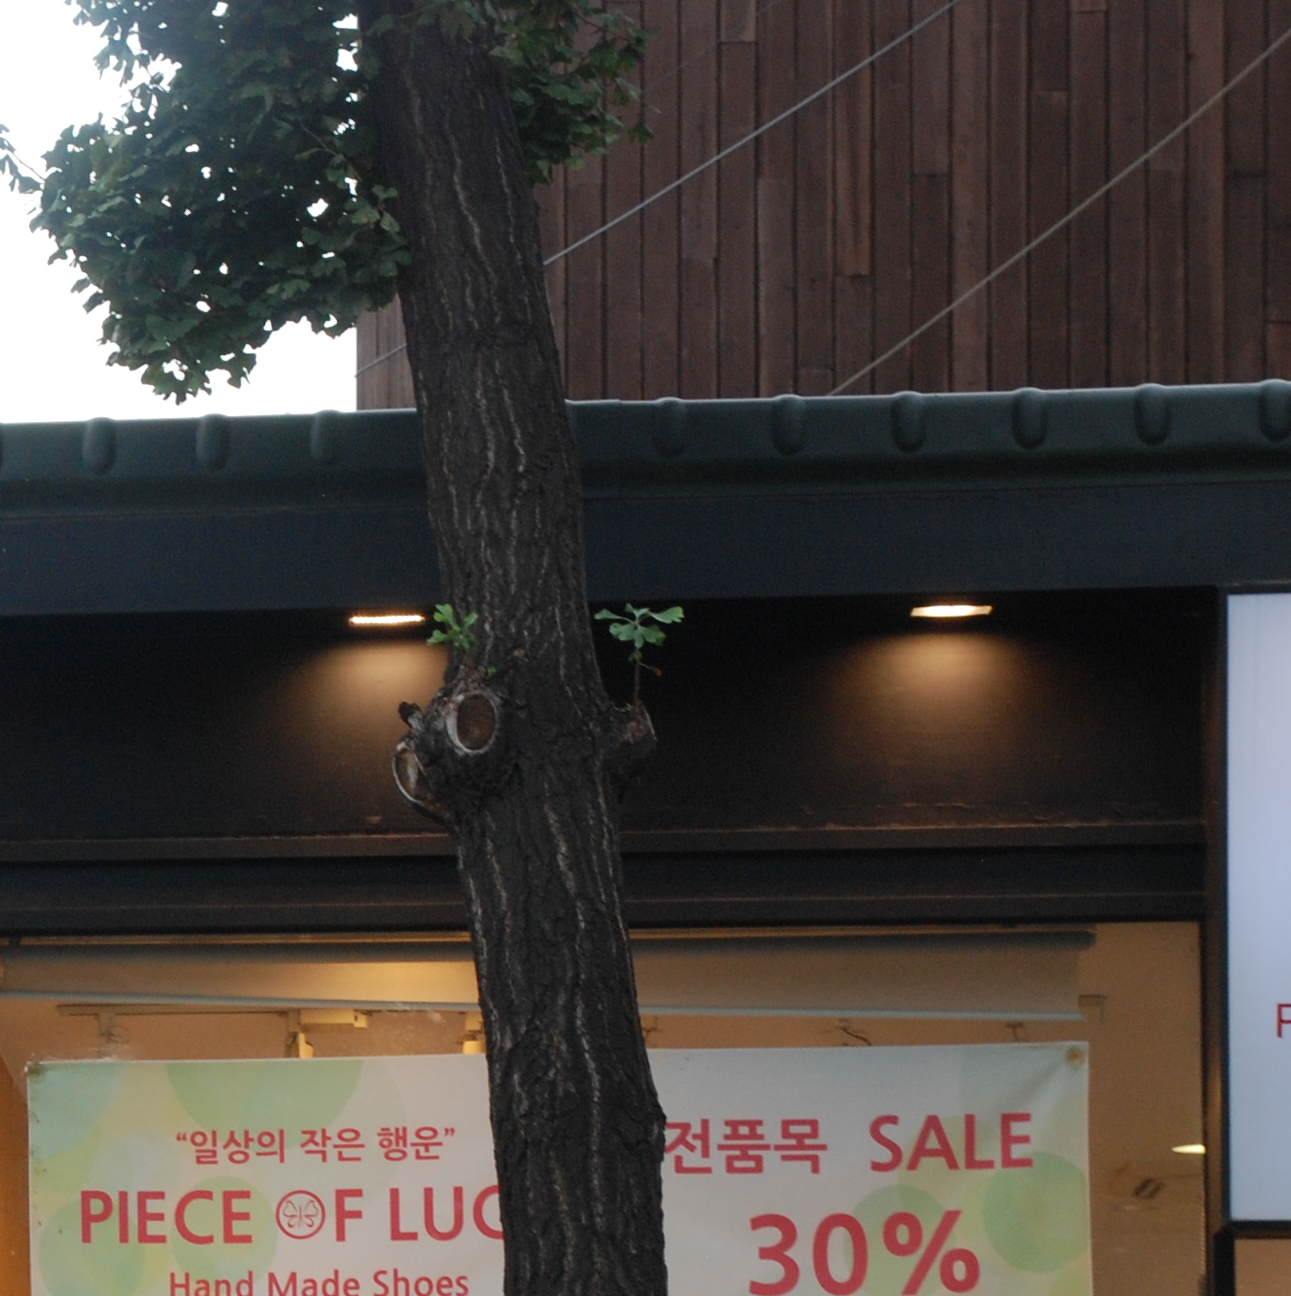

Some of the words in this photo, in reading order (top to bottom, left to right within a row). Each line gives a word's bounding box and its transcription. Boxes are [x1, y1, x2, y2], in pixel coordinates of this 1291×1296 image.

[299, 1127, 365, 1163] 작은
[663, 1118, 829, 1175] 전품목
[868, 1112, 1034, 1173] SALE
[79, 1189, 253, 1245] PIECE
